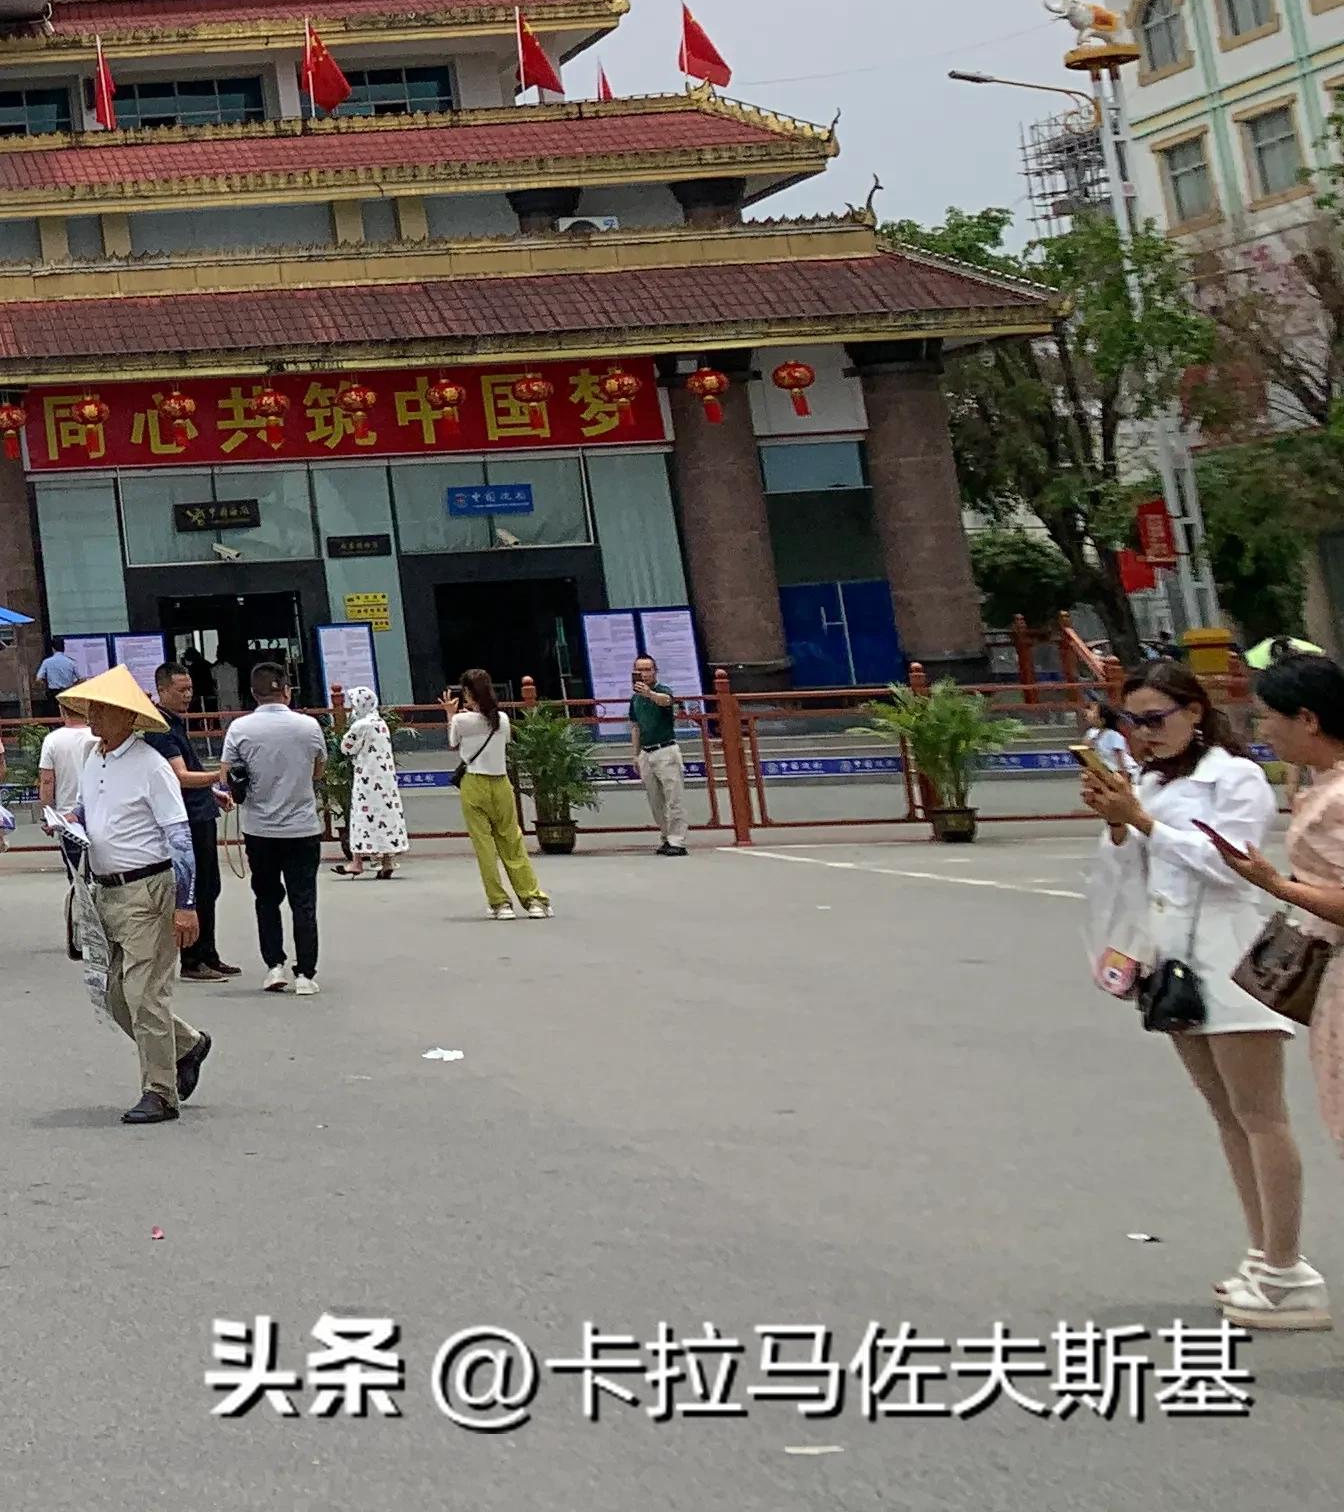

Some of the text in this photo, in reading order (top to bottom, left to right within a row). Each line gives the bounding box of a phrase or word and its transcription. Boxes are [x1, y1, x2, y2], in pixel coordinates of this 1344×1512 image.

[43, 367, 630, 461] 同心共筑中国梦
